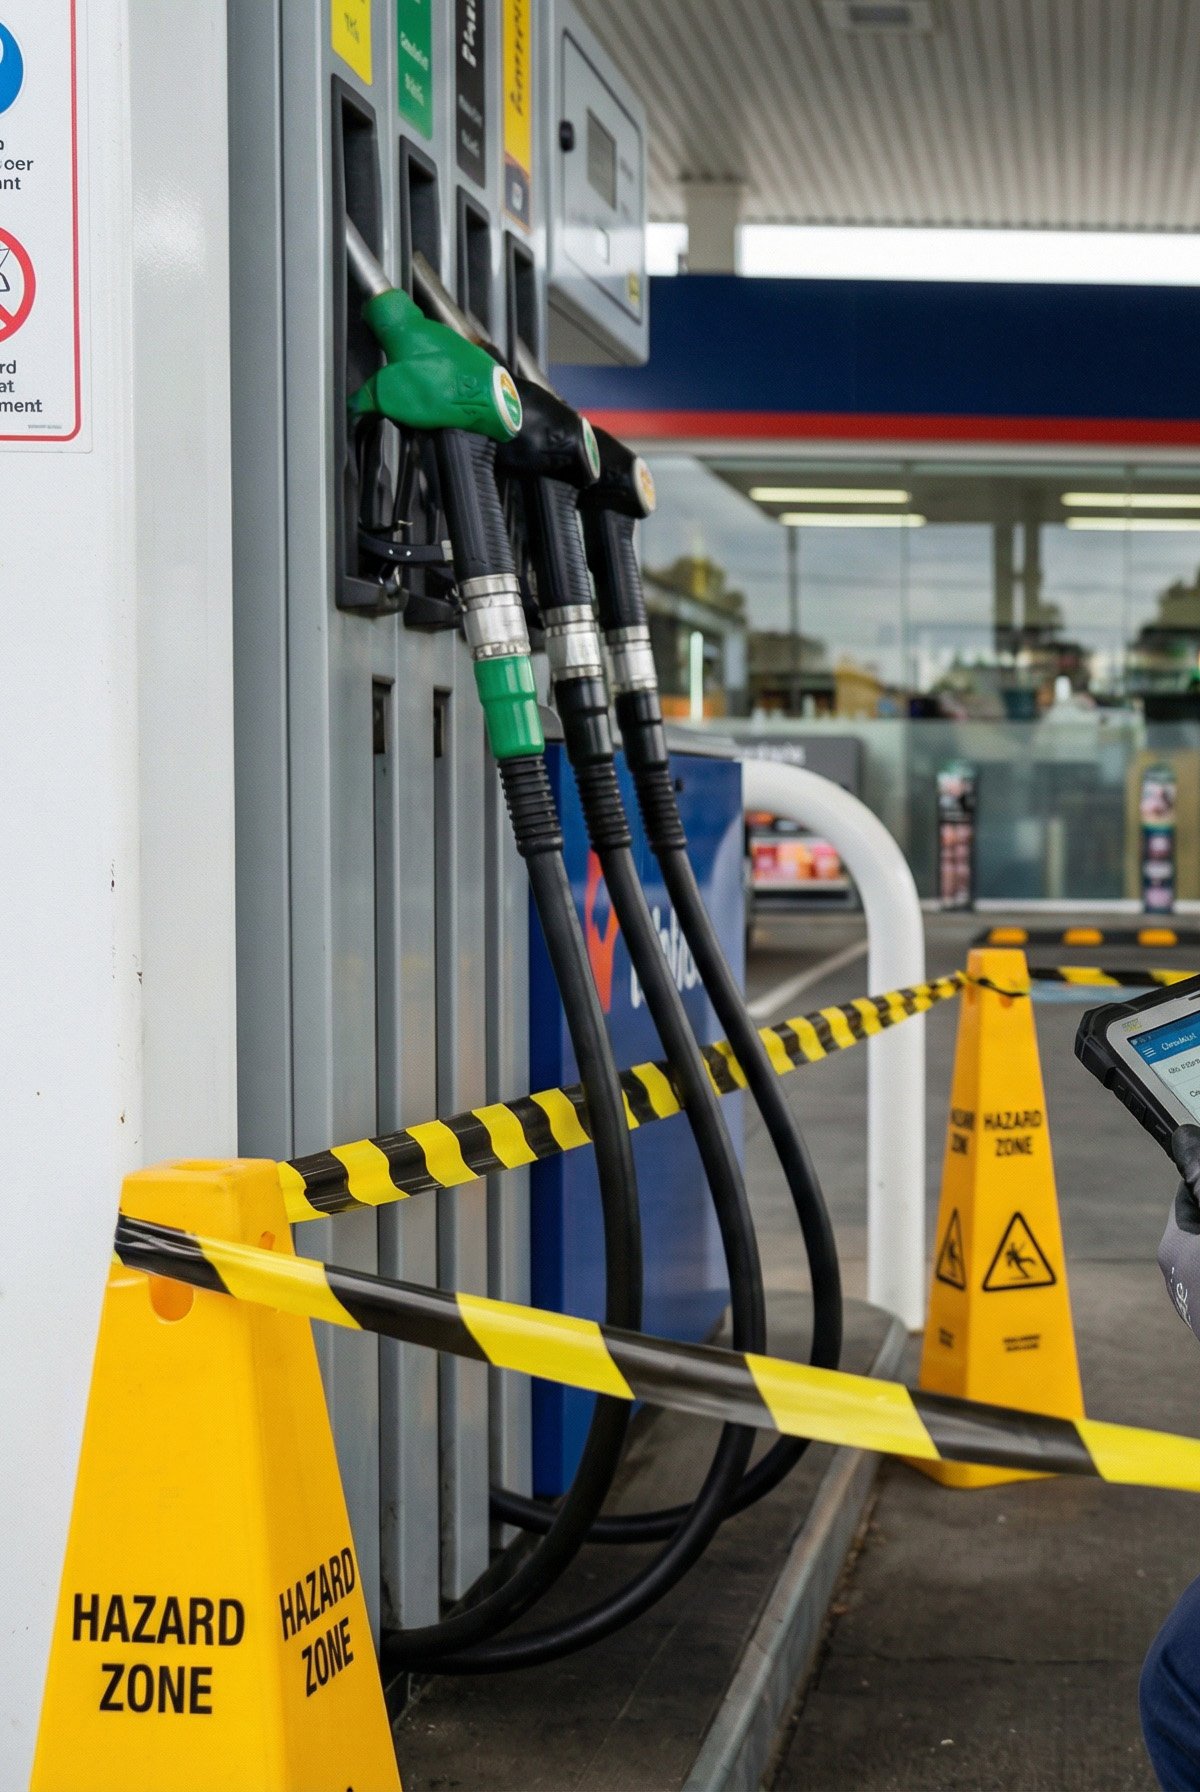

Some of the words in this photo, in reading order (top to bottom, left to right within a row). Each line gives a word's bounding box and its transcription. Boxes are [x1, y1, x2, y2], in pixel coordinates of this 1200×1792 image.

[0, 159, 34, 171] oer
[983, 1110, 1042, 1130] HAZARD
[995, 1135, 1033, 1156] ZONE
[72, 1593, 246, 1646] HAZARD
[279, 1547, 355, 1641] HAZARD
[301, 1616, 354, 1698] ZONE
[99, 1663, 213, 1715] ZONE
